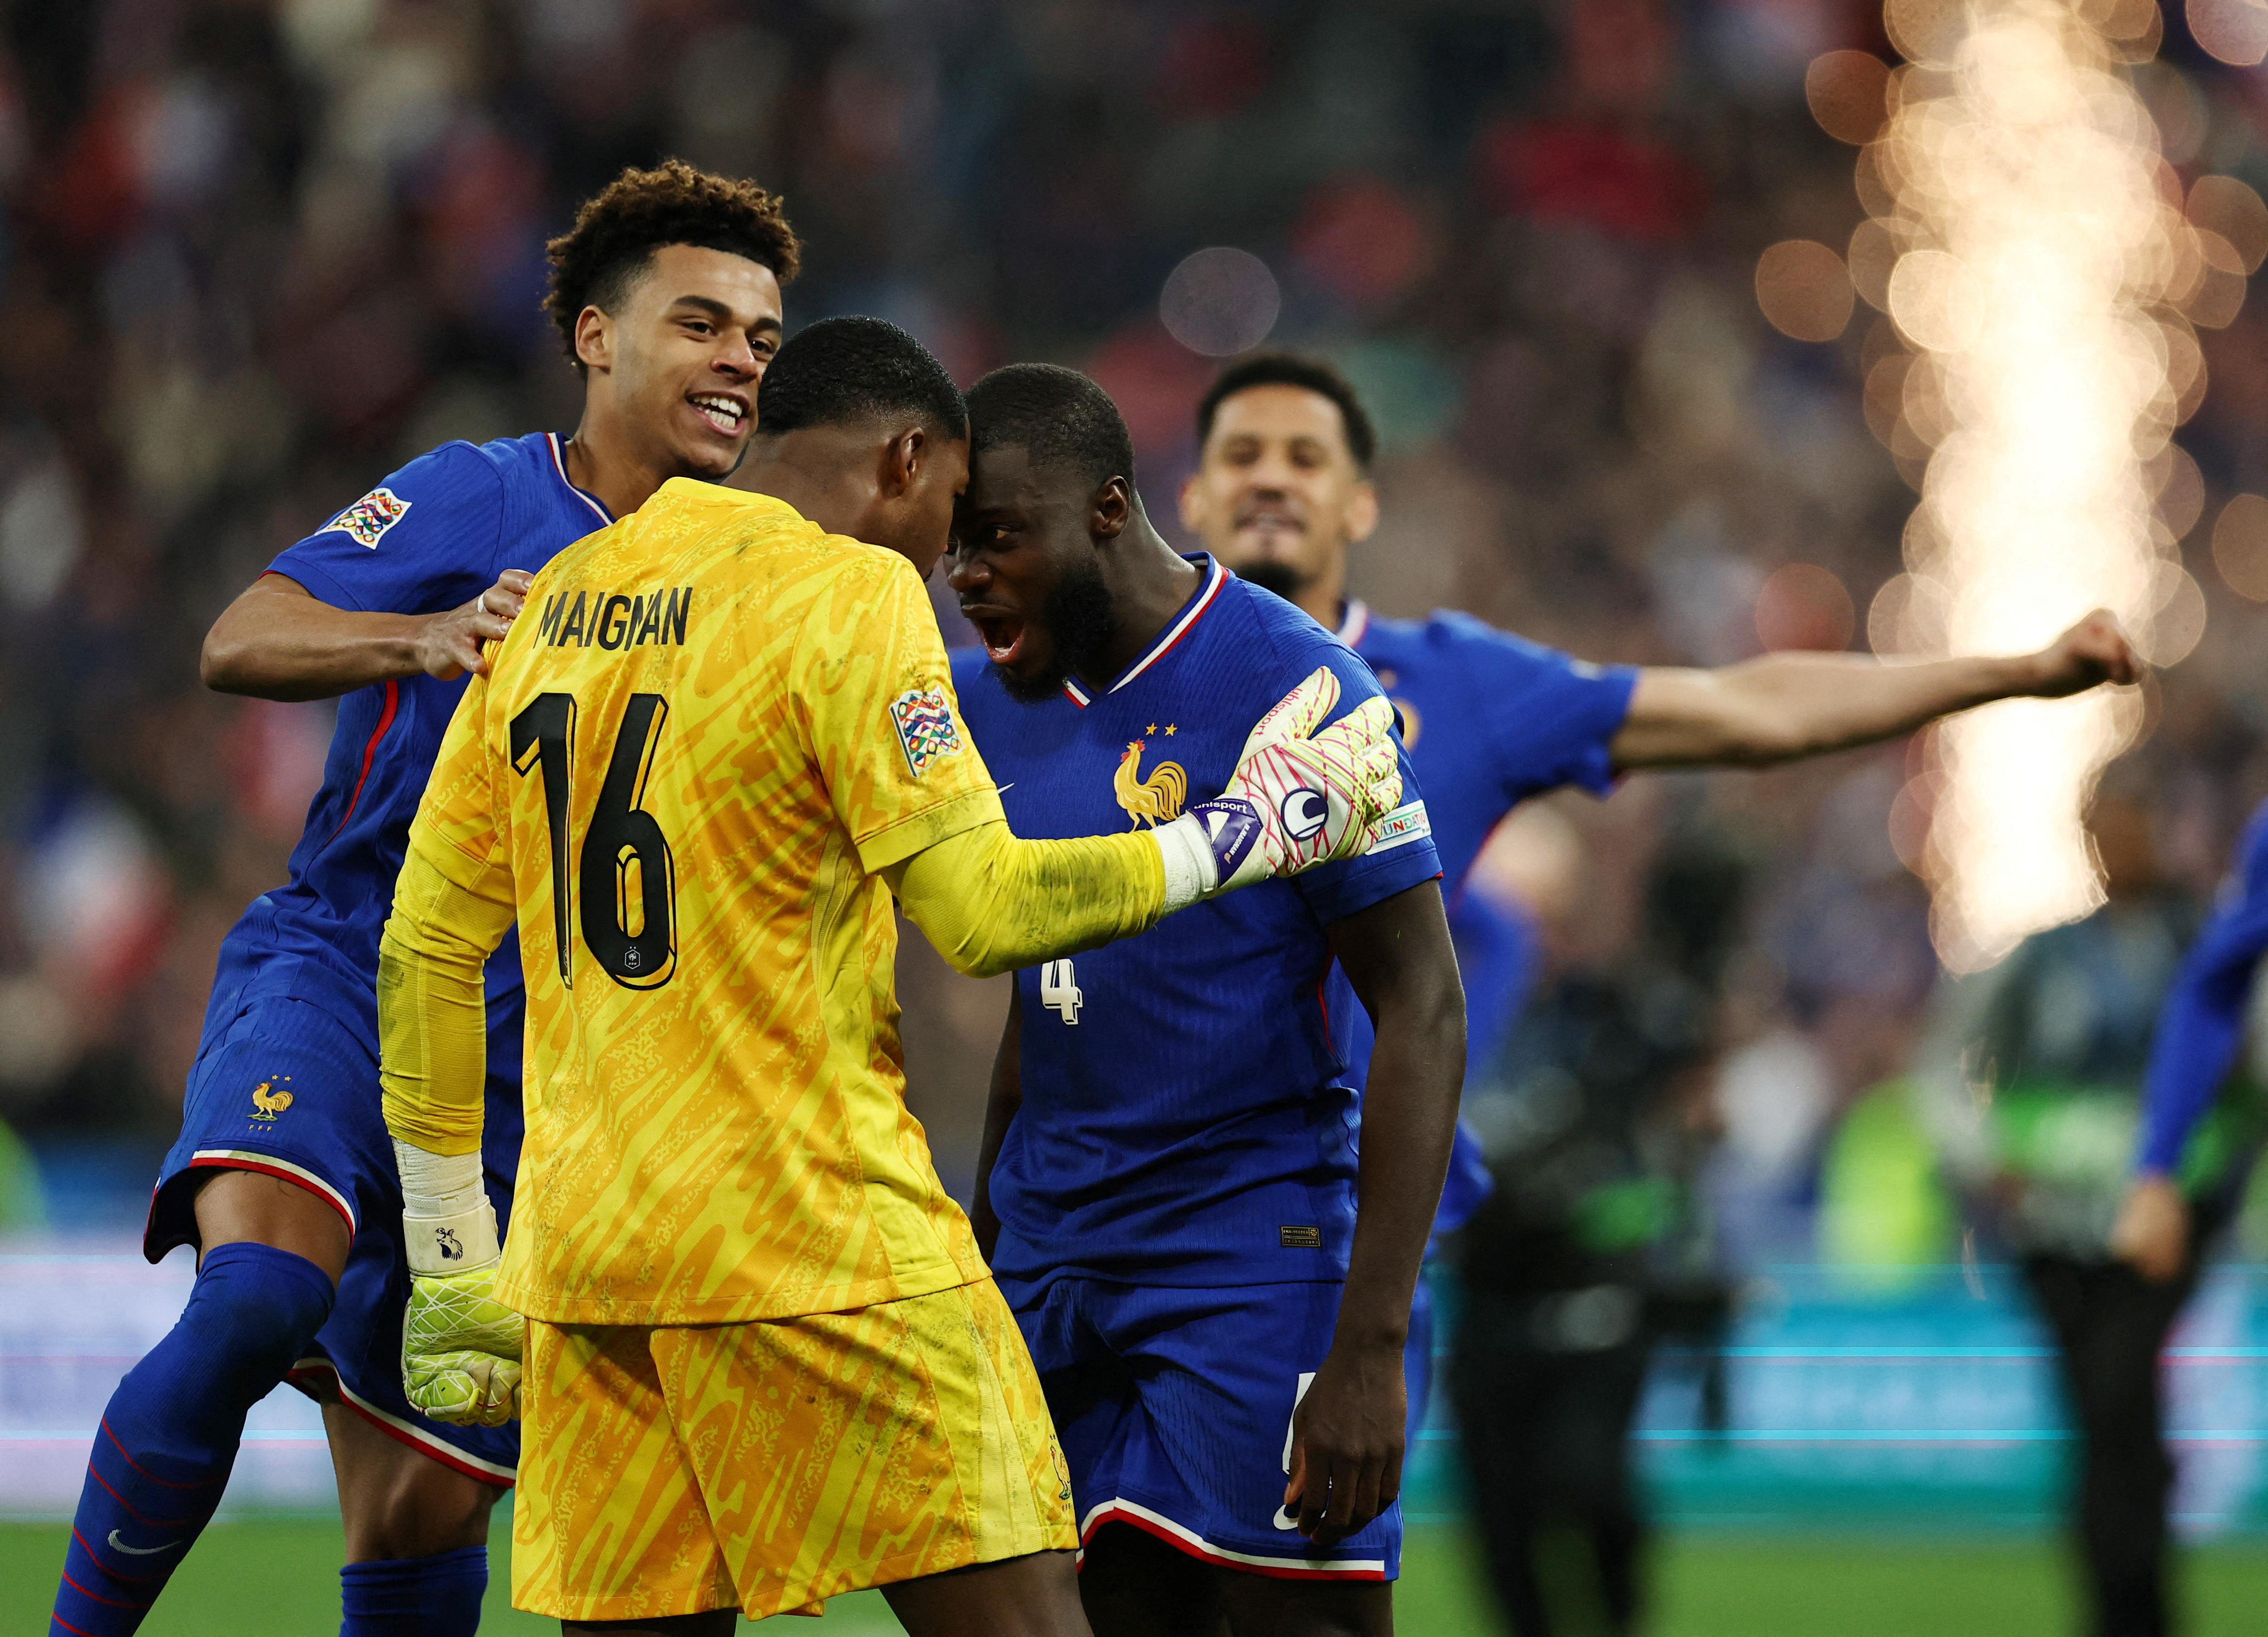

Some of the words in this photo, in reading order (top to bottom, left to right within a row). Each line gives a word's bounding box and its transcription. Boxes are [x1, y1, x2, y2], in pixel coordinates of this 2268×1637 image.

[532, 587, 693, 651] MAIGNAN
[1253, 688, 1303, 736] uhlsport
[510, 692, 677, 991] 16
[1041, 958, 1083, 1025] 4
